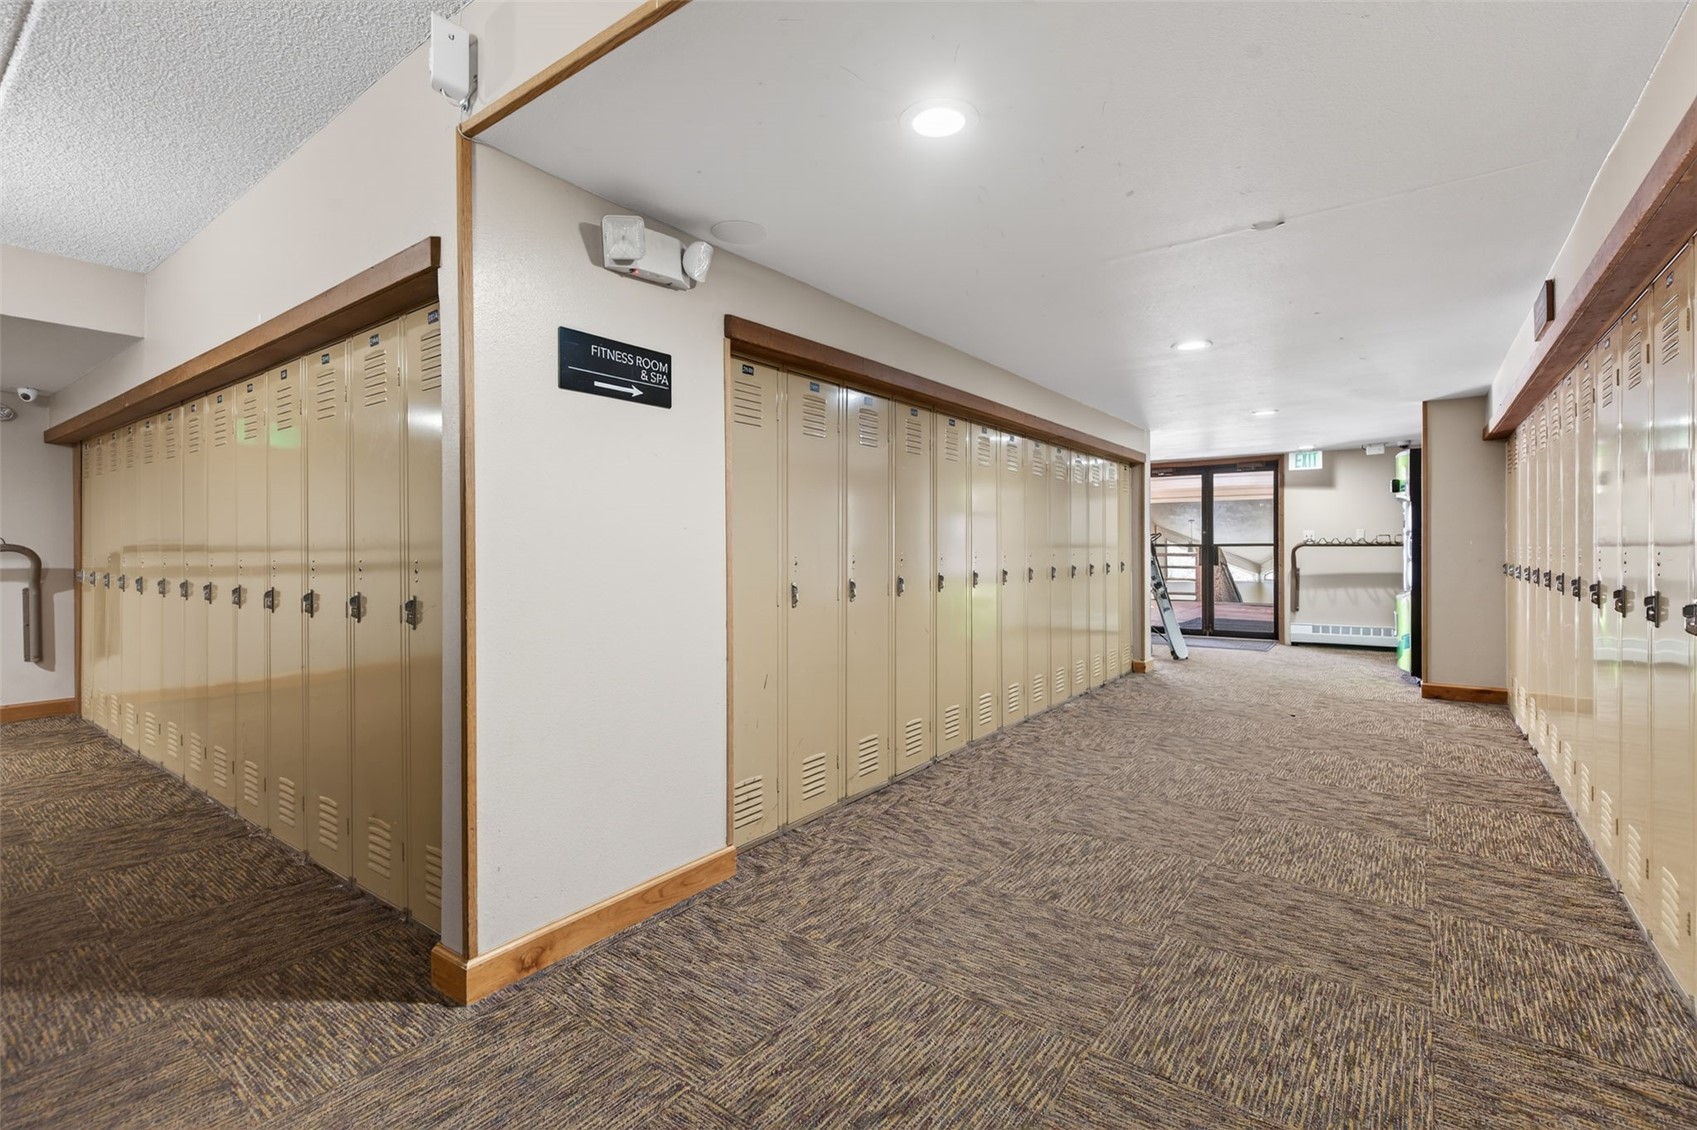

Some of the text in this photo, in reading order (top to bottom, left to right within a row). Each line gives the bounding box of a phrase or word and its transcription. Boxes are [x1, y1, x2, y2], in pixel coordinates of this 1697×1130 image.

[591, 345, 668, 374] FITNESS ROOM
[640, 370, 669, 386] & SPA
[1295, 452, 1318, 468] EXIT
